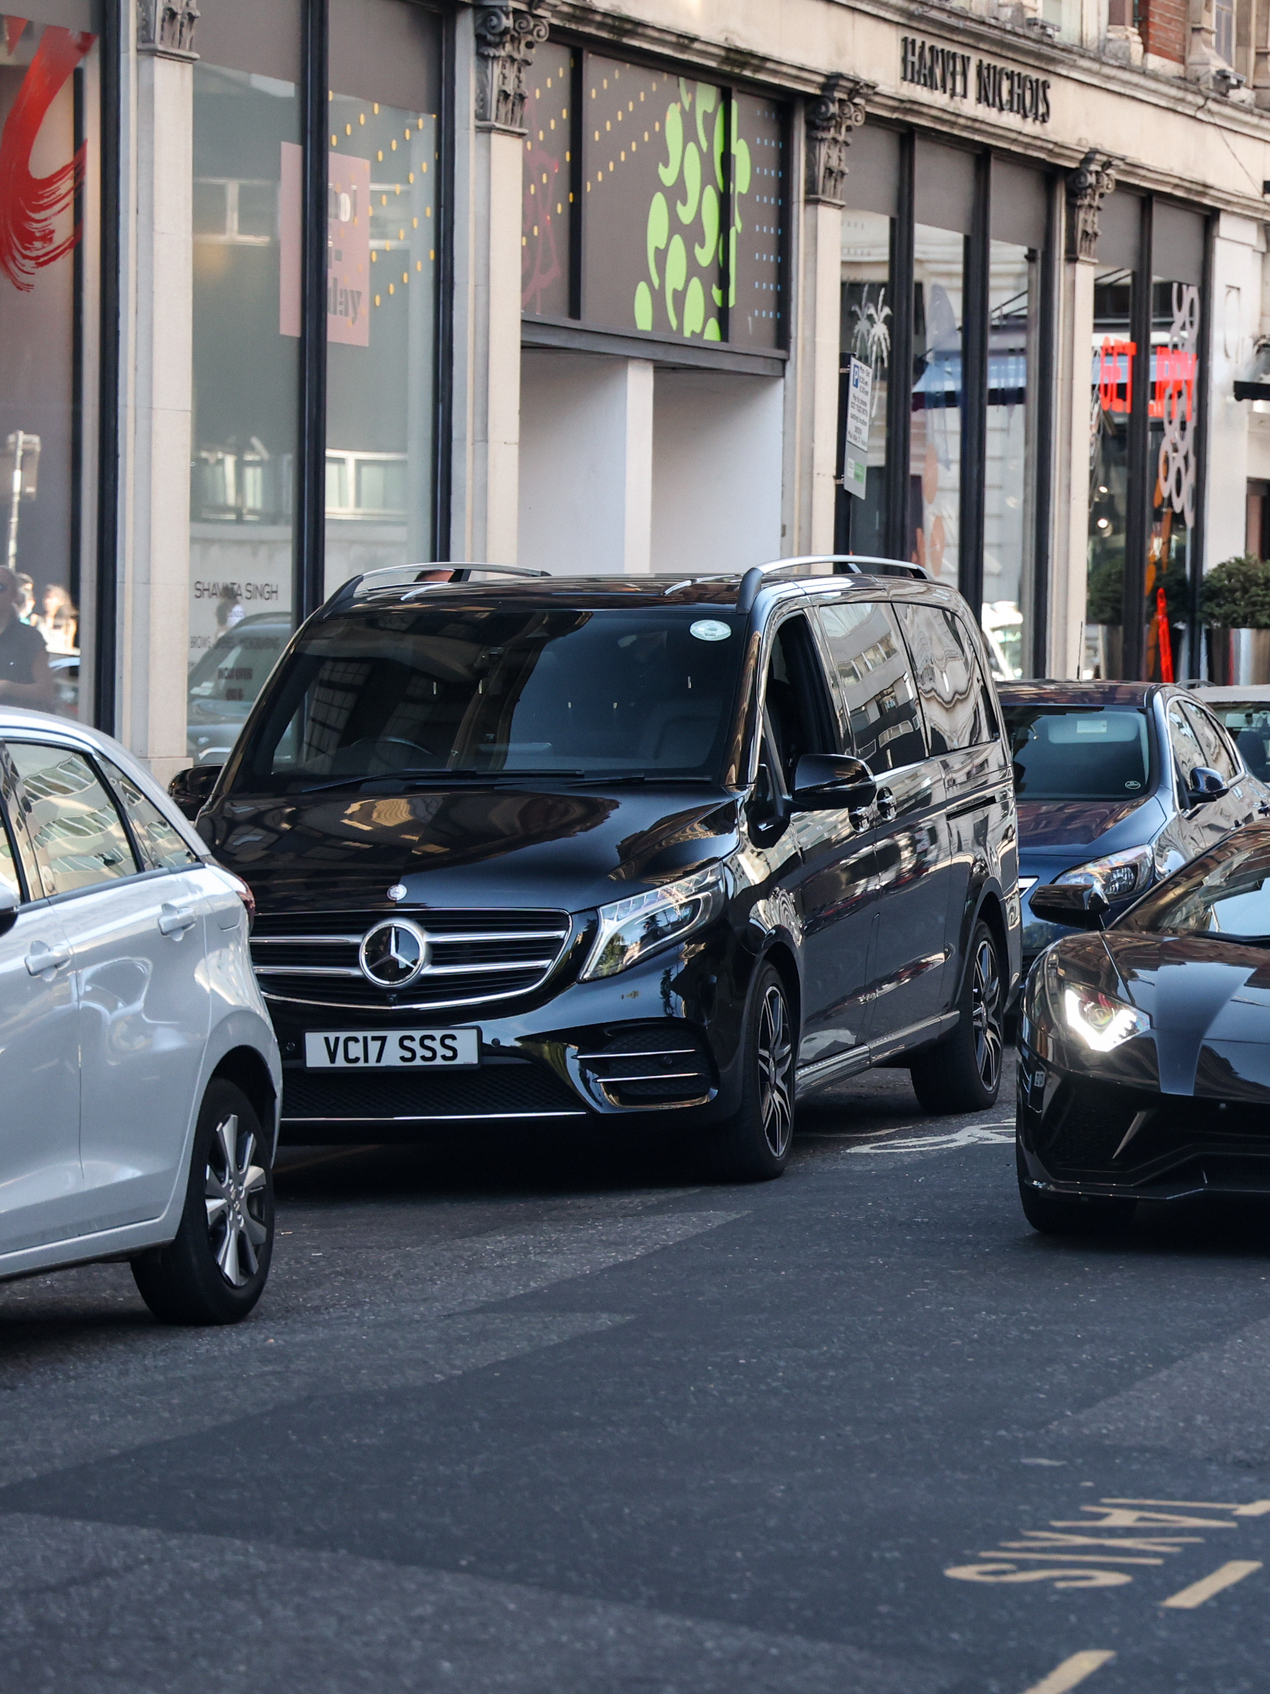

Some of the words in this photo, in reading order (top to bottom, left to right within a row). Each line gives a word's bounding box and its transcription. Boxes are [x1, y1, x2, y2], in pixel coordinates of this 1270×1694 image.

[901, 36, 971, 99] HARVEY
[976, 58, 1051, 124] NICHOLS
[1100, 336, 1137, 414] GET
[194, 581, 243, 599] SHAVTA
[245, 582, 278, 601] SINGH
[323, 1035, 388, 1064] VC17
[398, 1034, 458, 1063] SSS
